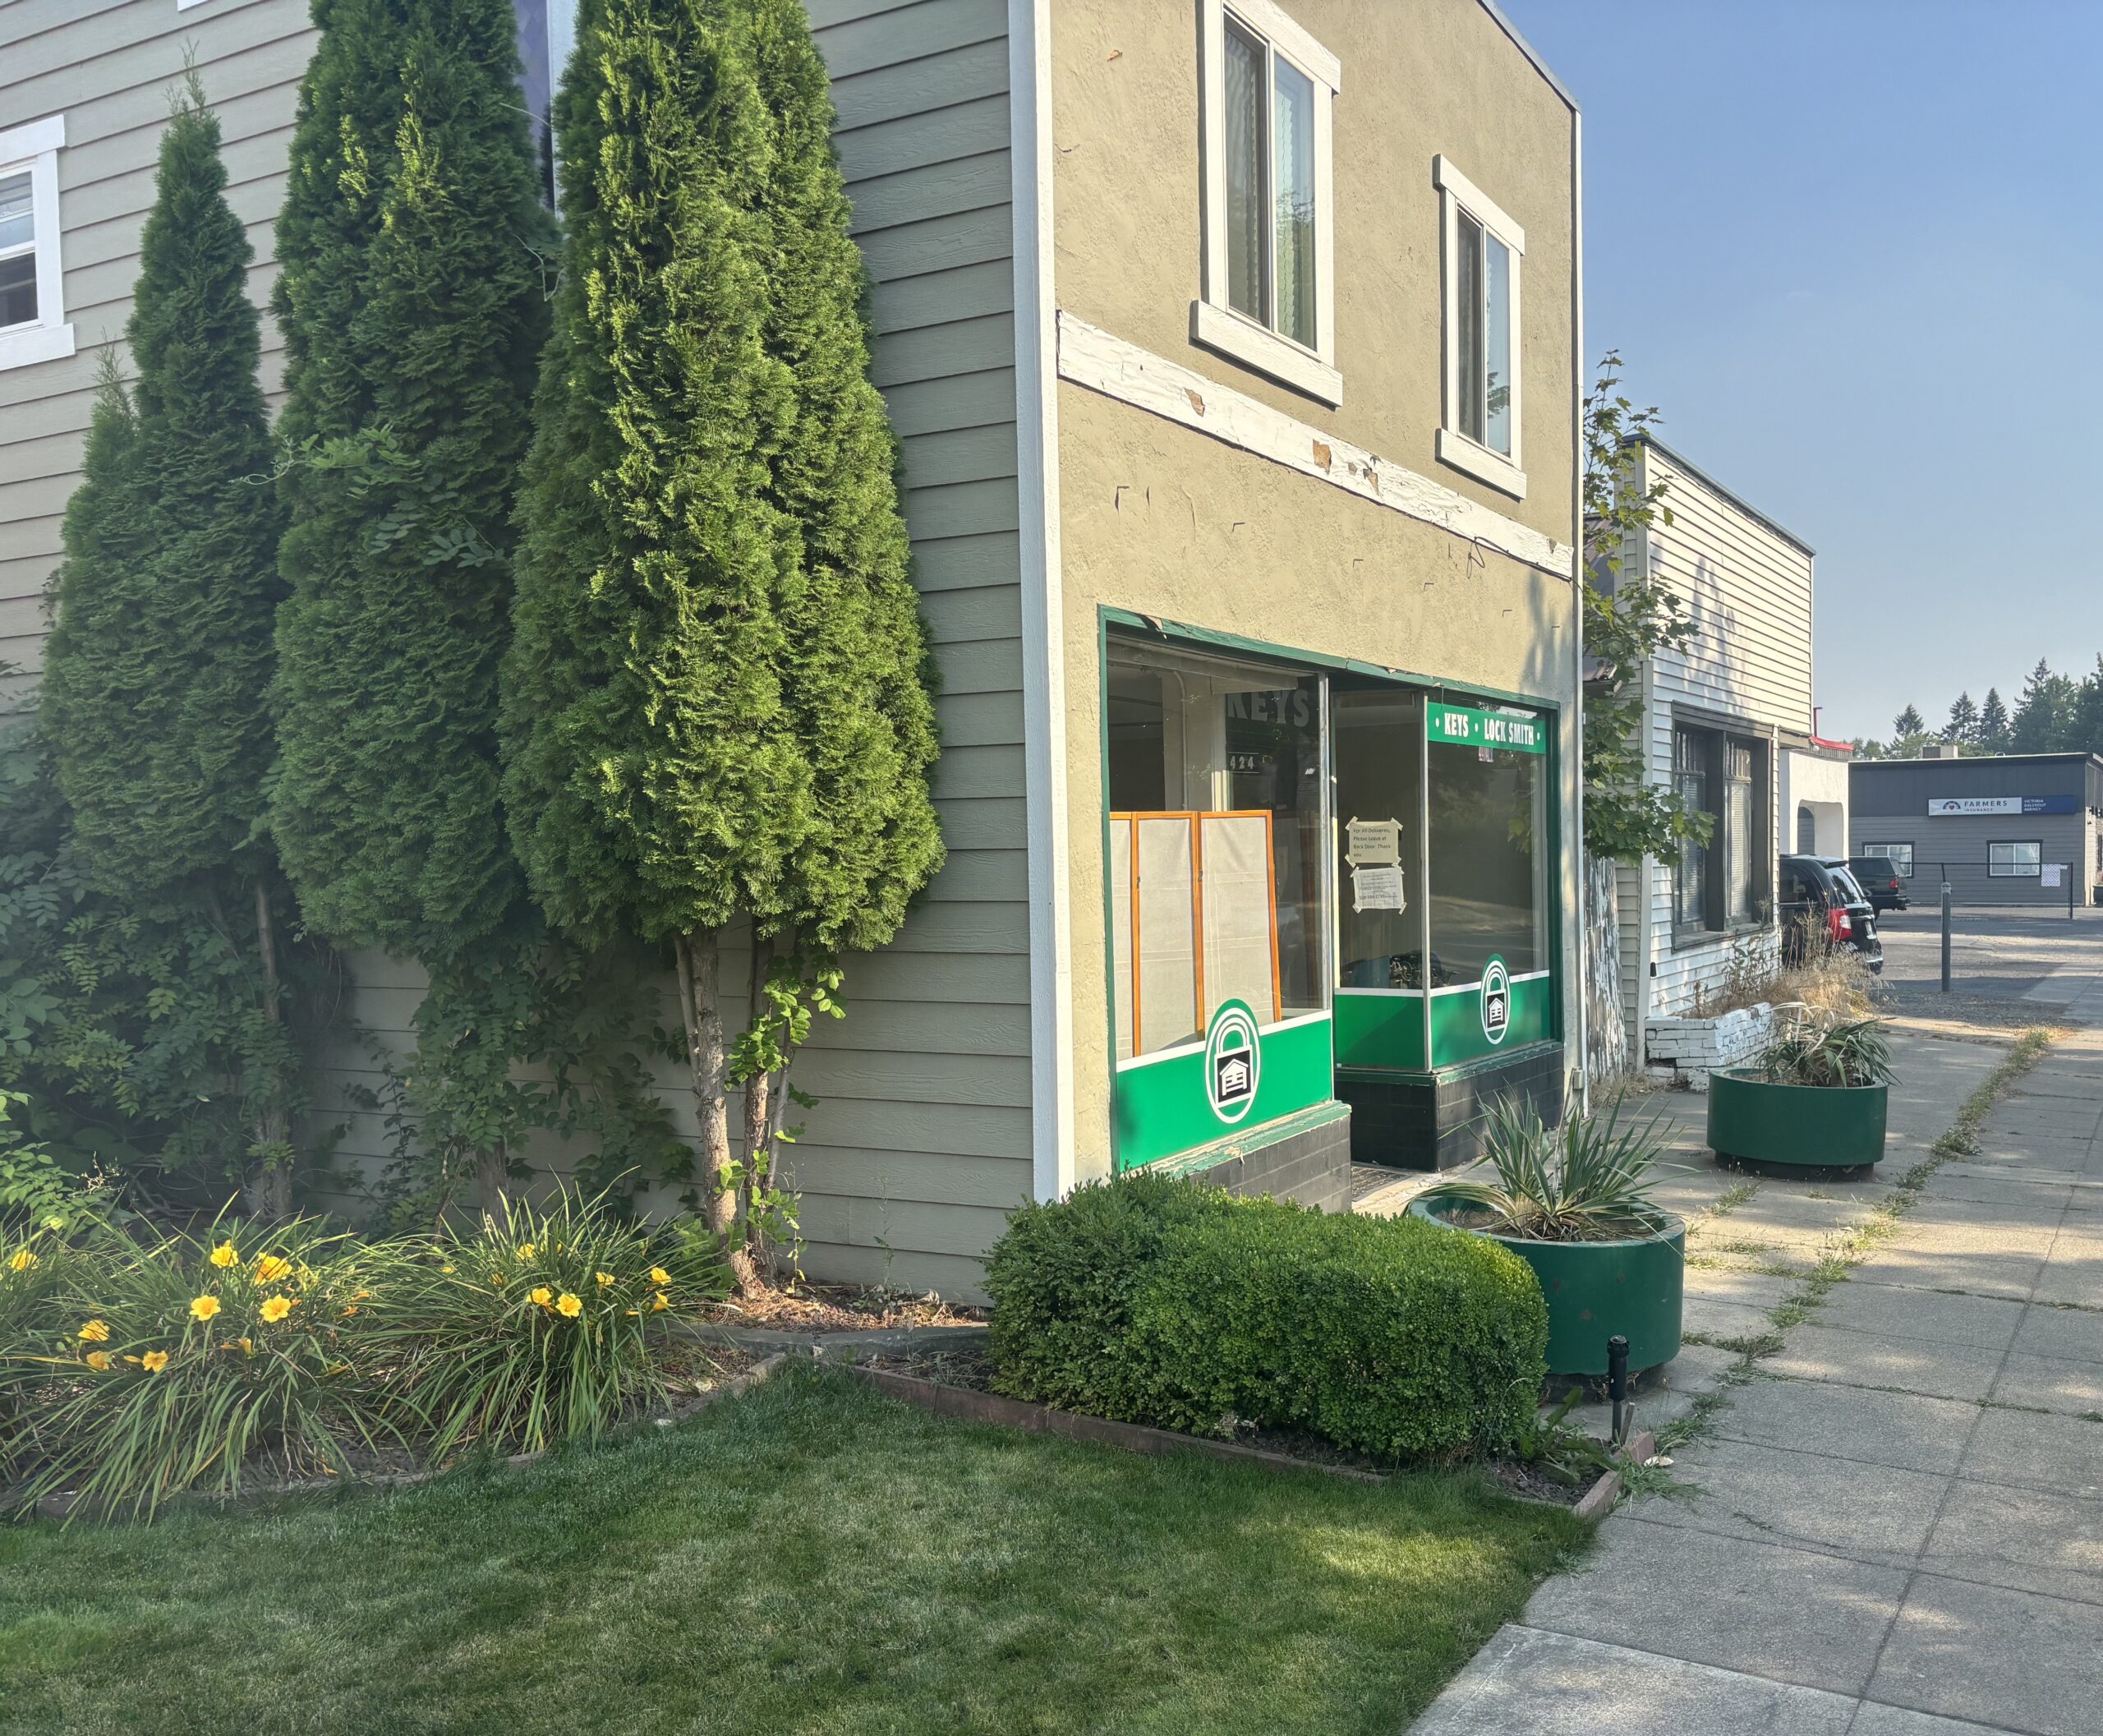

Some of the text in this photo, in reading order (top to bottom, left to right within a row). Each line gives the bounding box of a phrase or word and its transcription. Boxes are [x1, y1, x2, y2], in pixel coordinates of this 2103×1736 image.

[1227, 689, 1309, 727] KEYS
[1444, 712, 1535, 745] KEYS LOCK SMITH
[1230, 756, 1254, 769] 424
